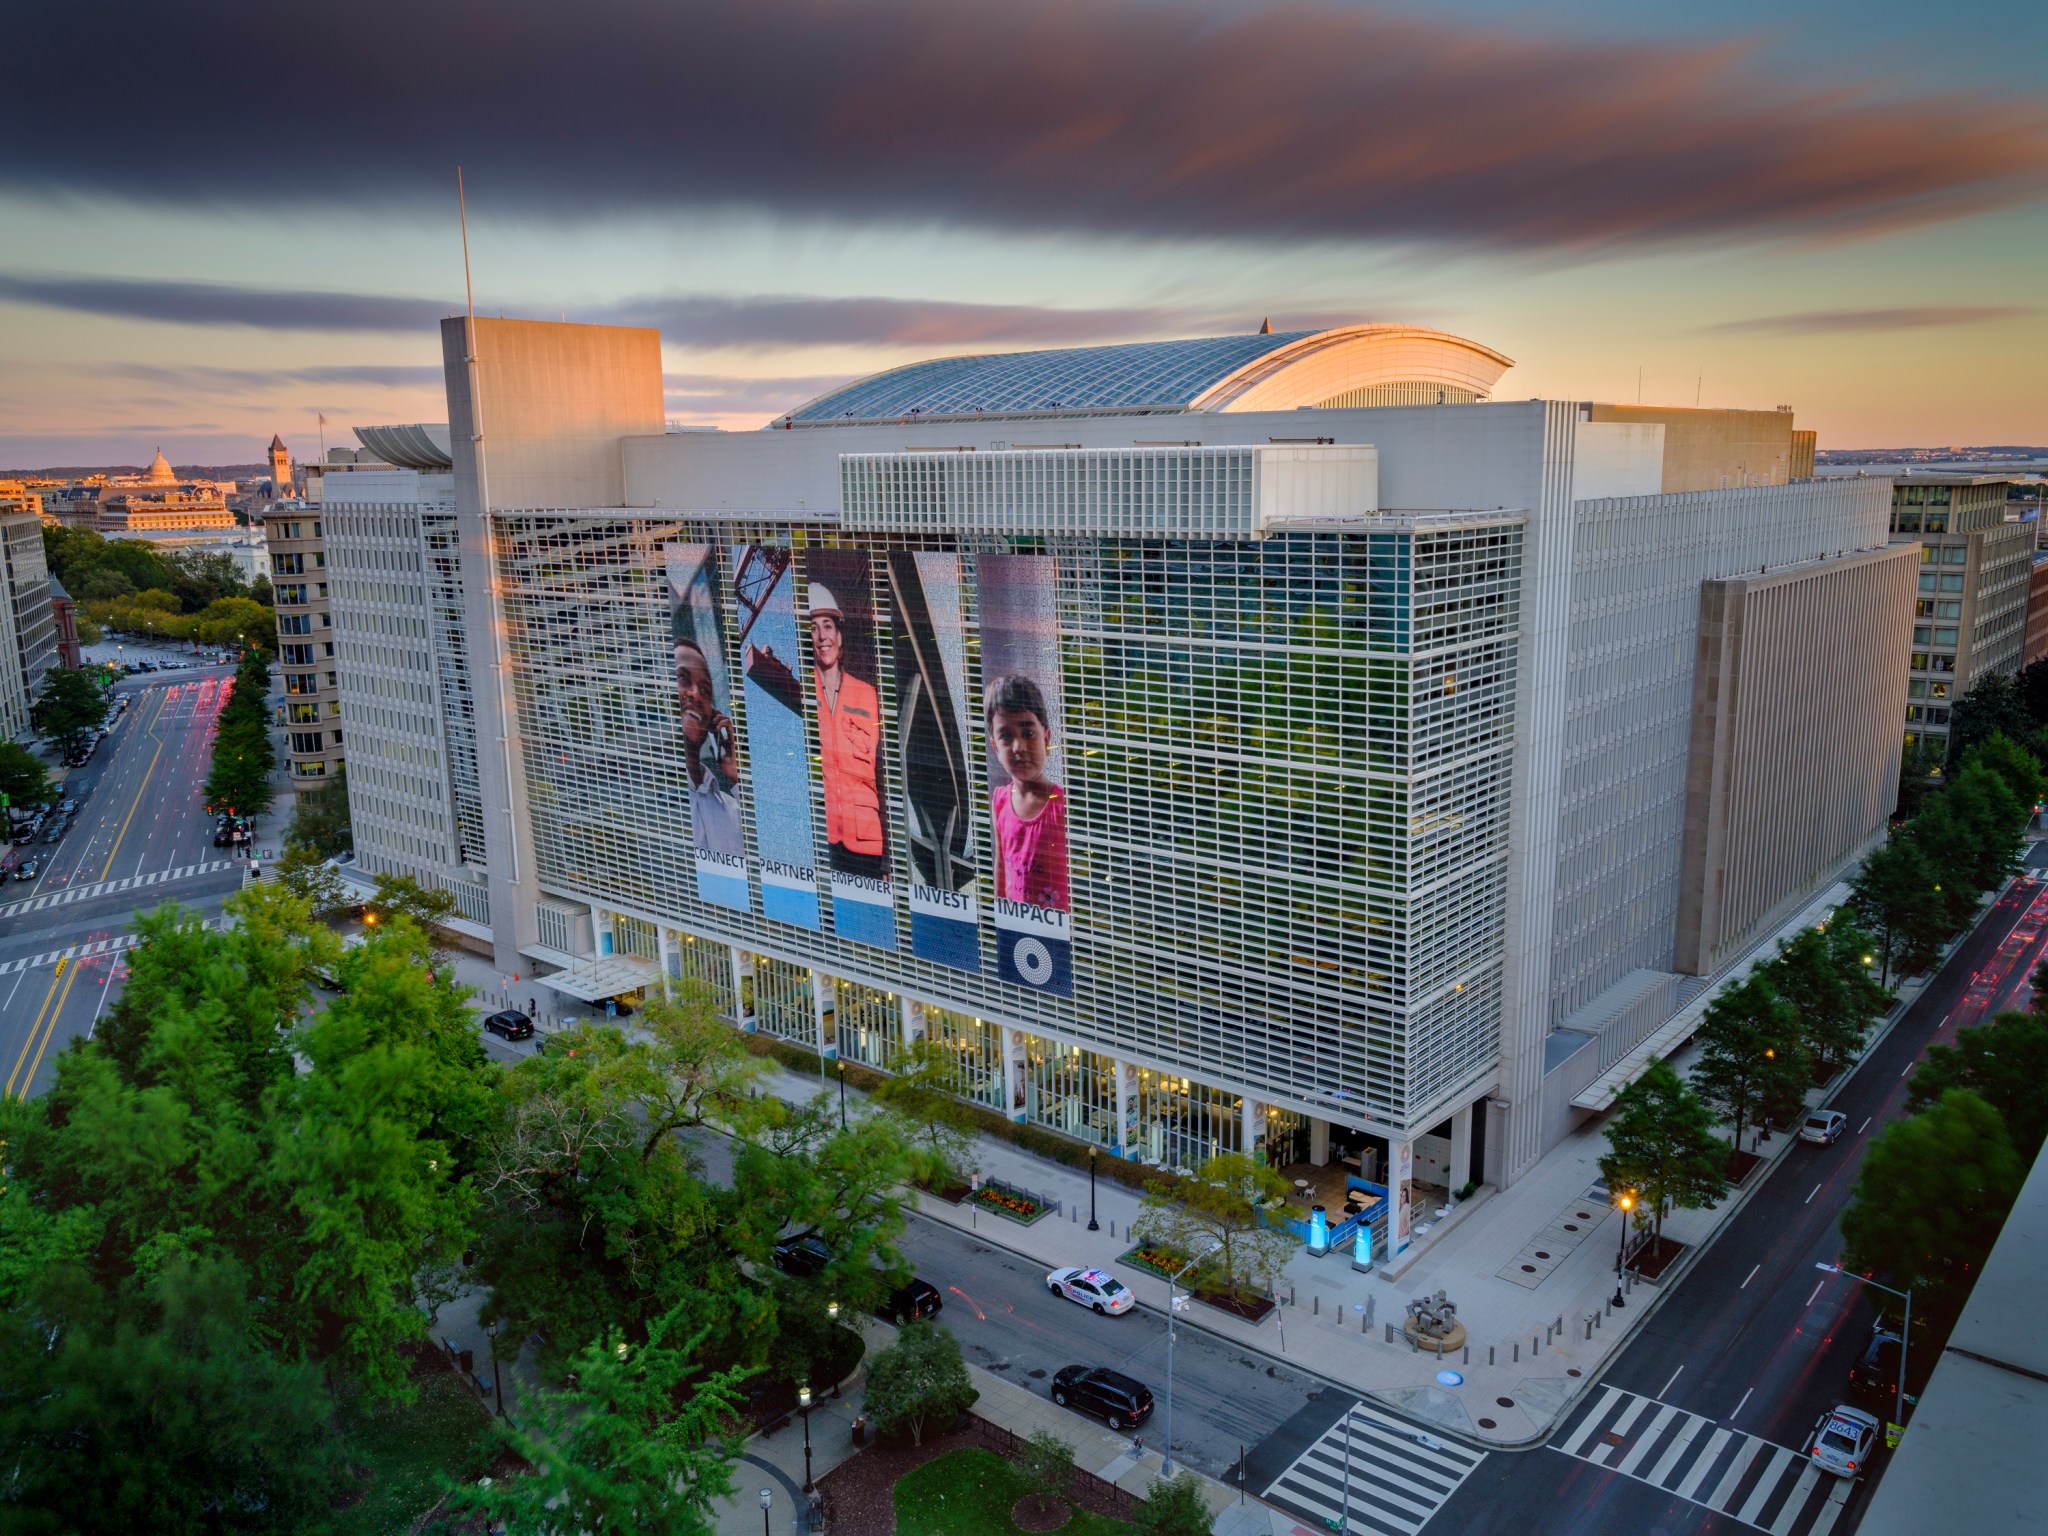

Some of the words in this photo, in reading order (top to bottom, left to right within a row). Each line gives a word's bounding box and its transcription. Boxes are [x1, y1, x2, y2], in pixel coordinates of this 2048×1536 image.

[760, 857, 816, 883] PARTNER
[831, 870, 892, 895] EMPOWER
[914, 883, 970, 911] INVEST
[997, 897, 1066, 927] IMPACT
[1072, 1290, 1093, 1300] POLICE
[1830, 1421, 1858, 1439] 8643
